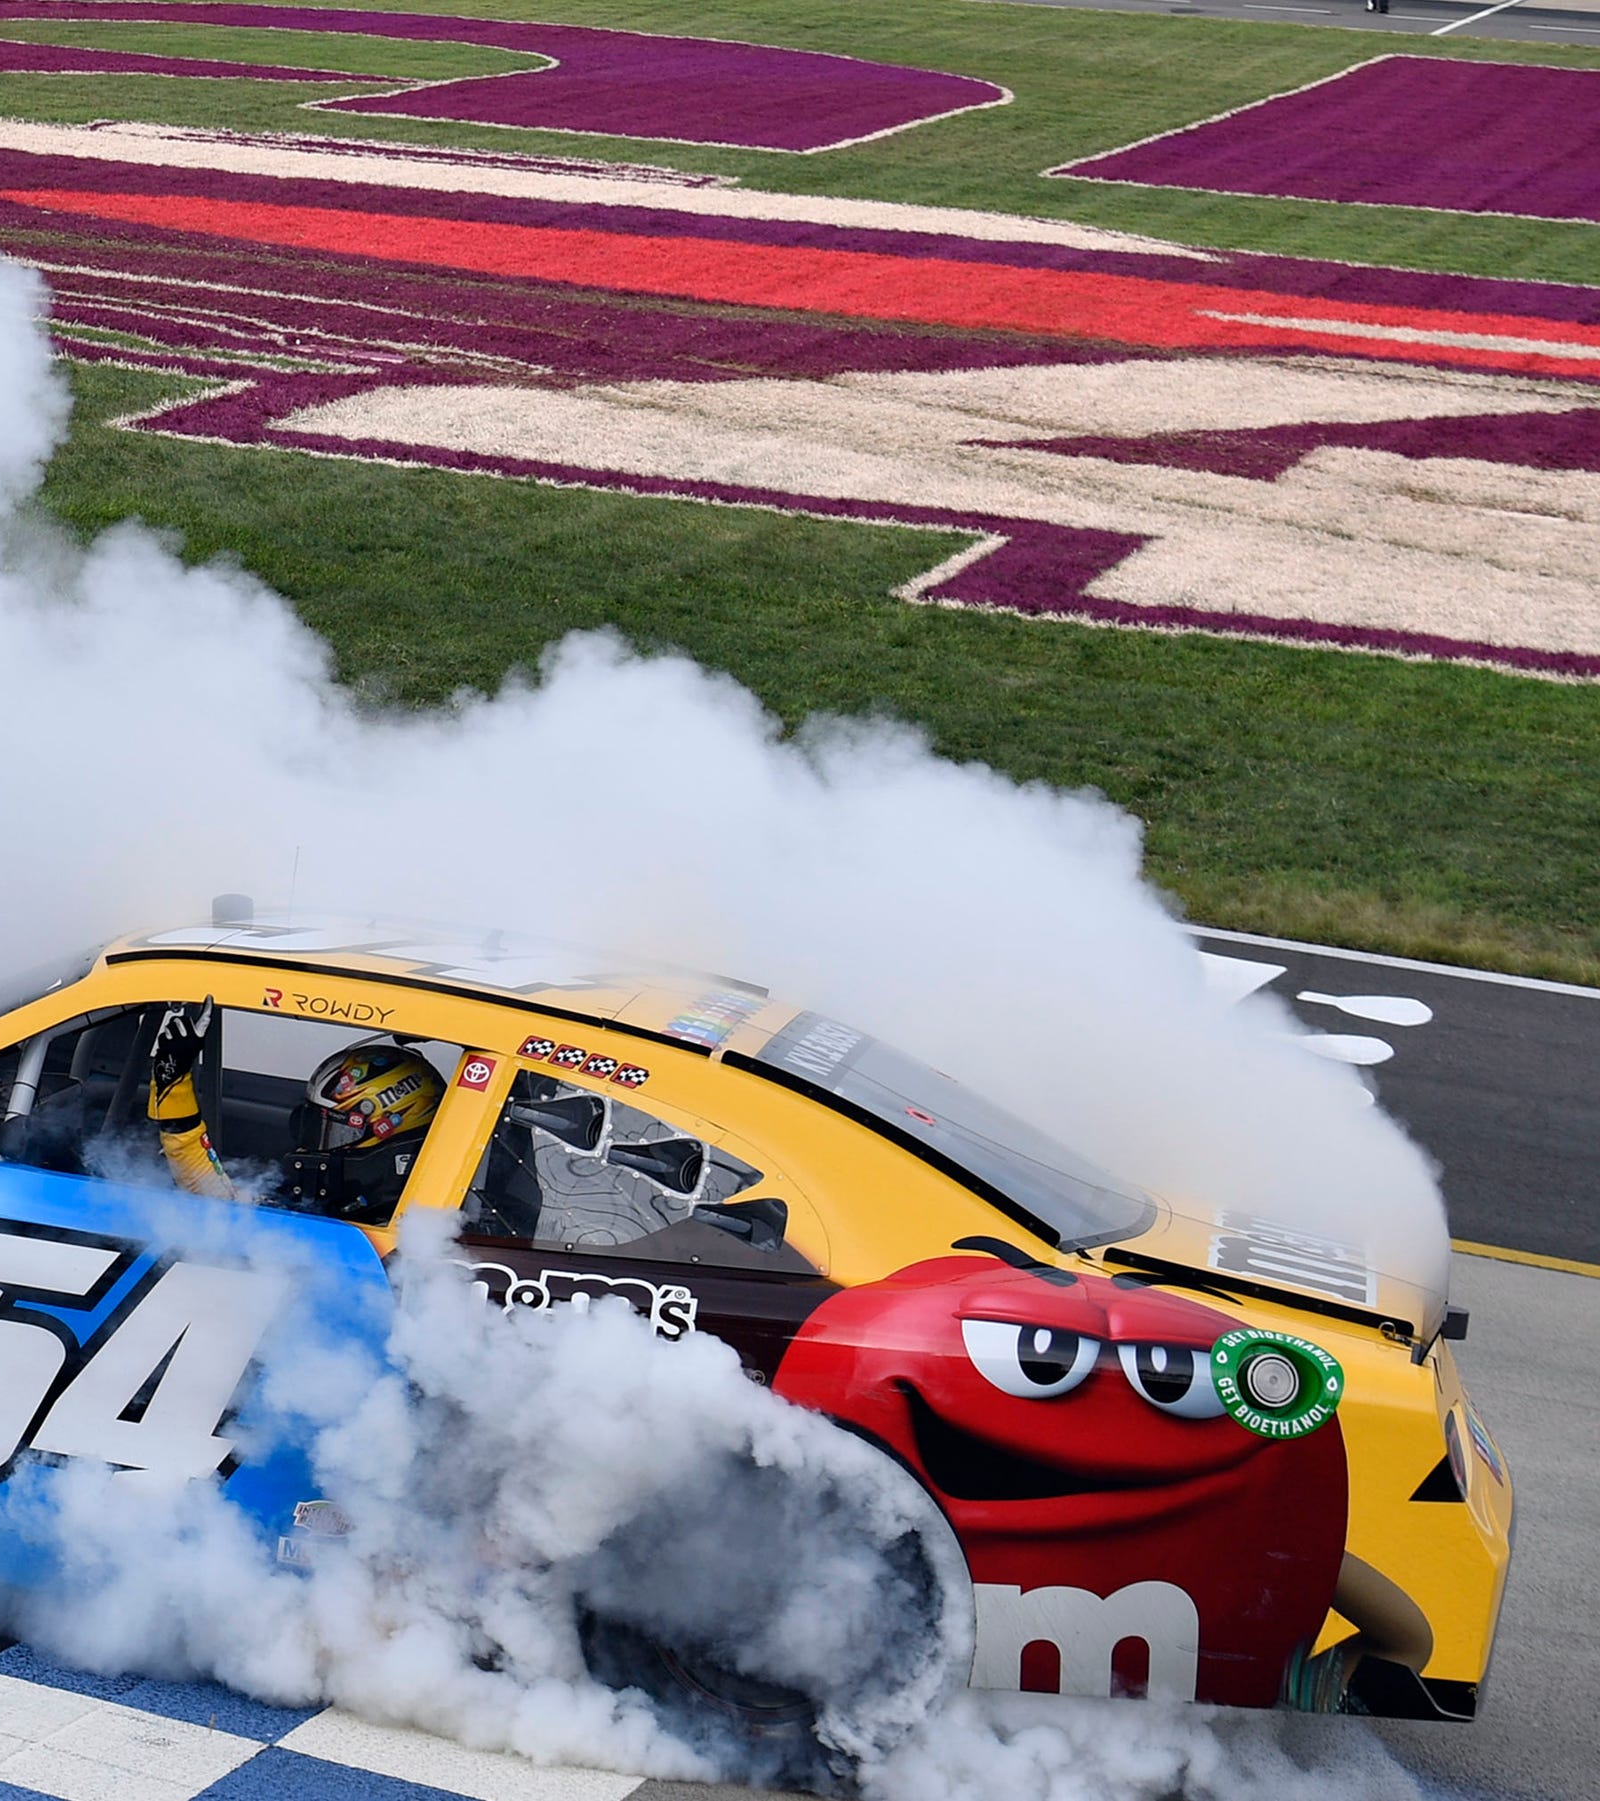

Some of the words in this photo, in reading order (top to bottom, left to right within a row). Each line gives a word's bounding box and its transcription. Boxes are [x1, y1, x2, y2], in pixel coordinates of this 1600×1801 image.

[292, 993, 395, 1024] ROWDY
[1222, 1331, 1247, 1348] GET
[1247, 1330, 1337, 1371] BIOETHANOL
[1218, 1377, 1241, 1404] GET
[1235, 1404, 1330, 1435] BIOETHANOL
